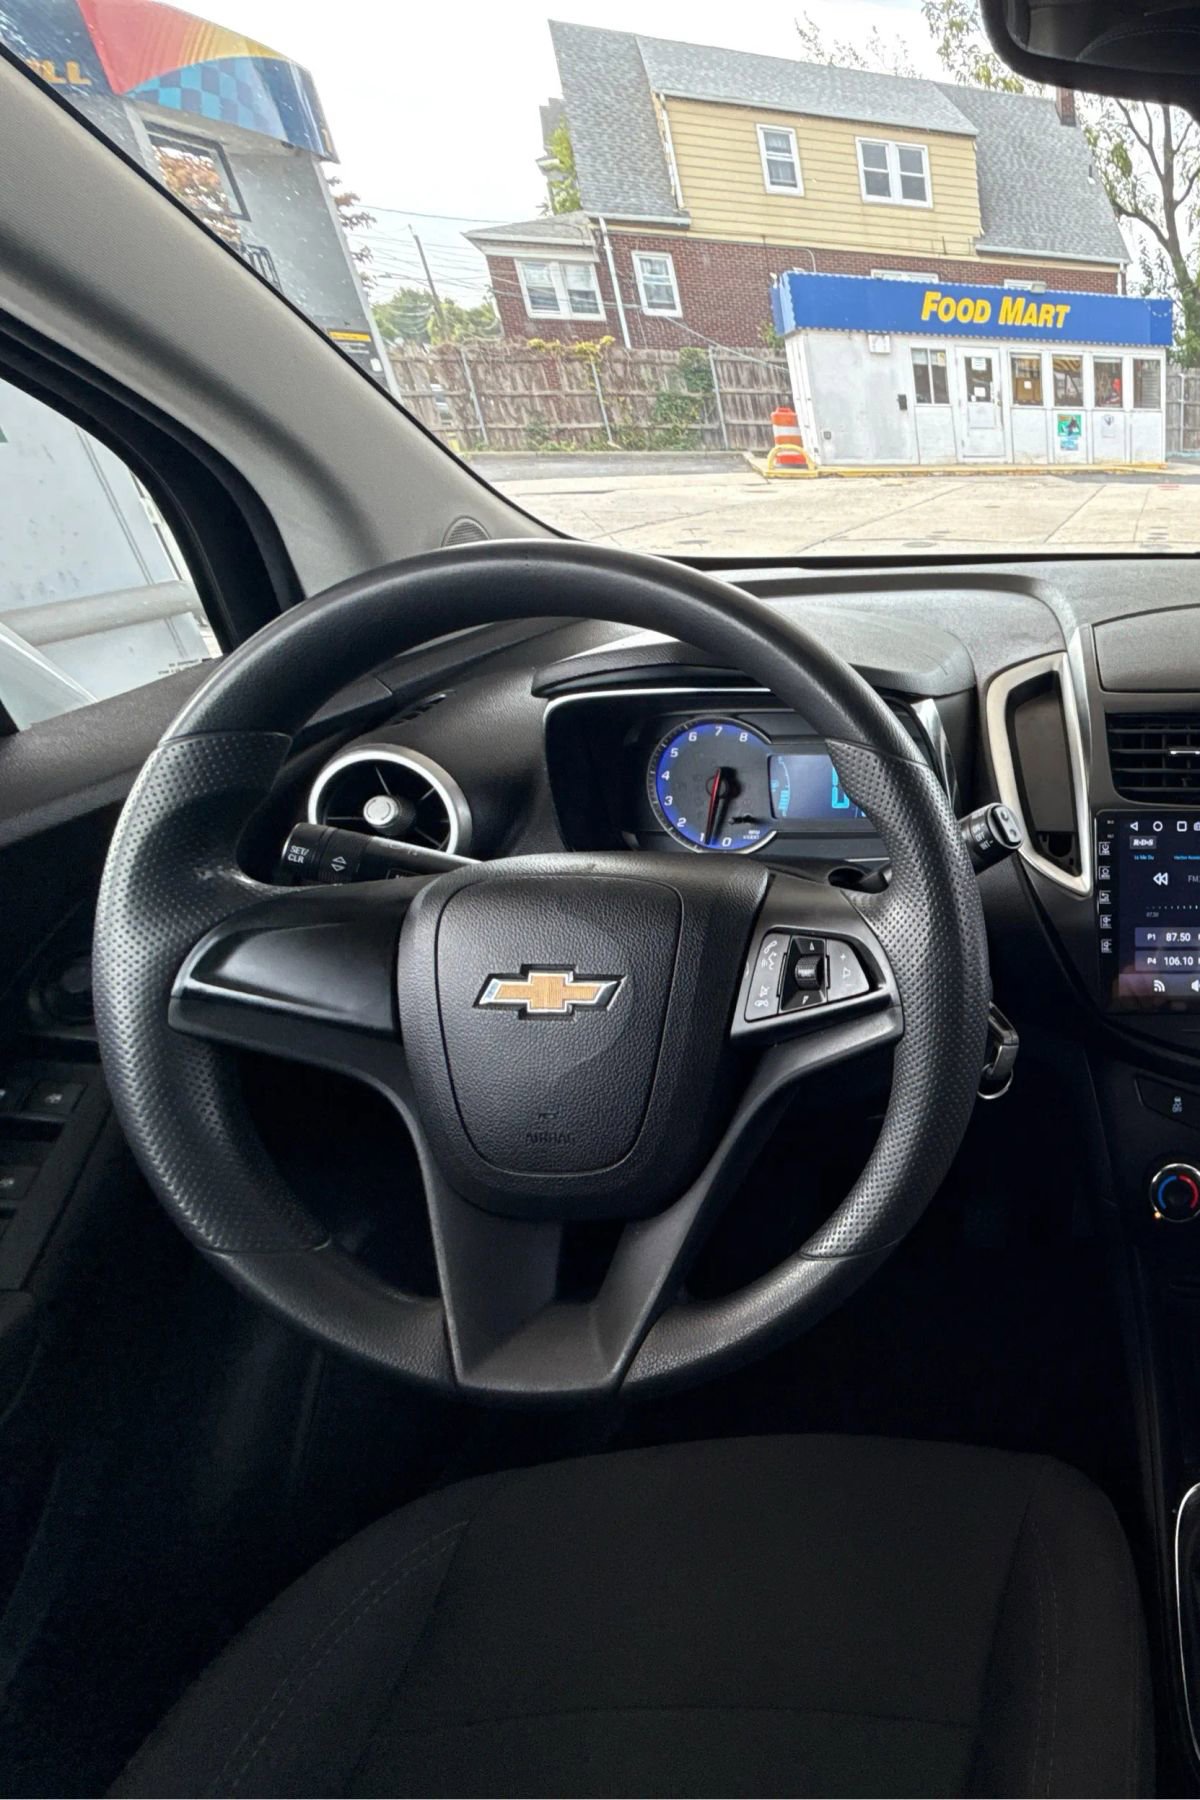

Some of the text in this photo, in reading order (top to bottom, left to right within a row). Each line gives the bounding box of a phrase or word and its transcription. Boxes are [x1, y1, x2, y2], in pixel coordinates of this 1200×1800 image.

[714, 726, 723, 736] 7
[688, 732, 698, 742] 6
[739, 733, 748, 742] 8
[670, 748, 679, 758] 5
[661, 771, 670, 780] 4
[664, 796, 673, 806] 3
[676, 817, 687, 827] 2
[699, 832, 705, 842] 1
[722, 836, 732, 847] 0
[1147, 933, 1156, 941] P1
[1166, 932, 1191, 942] 87.50
[1147, 957, 1157, 965] P4
[1164, 956, 1193, 966] 106.10
